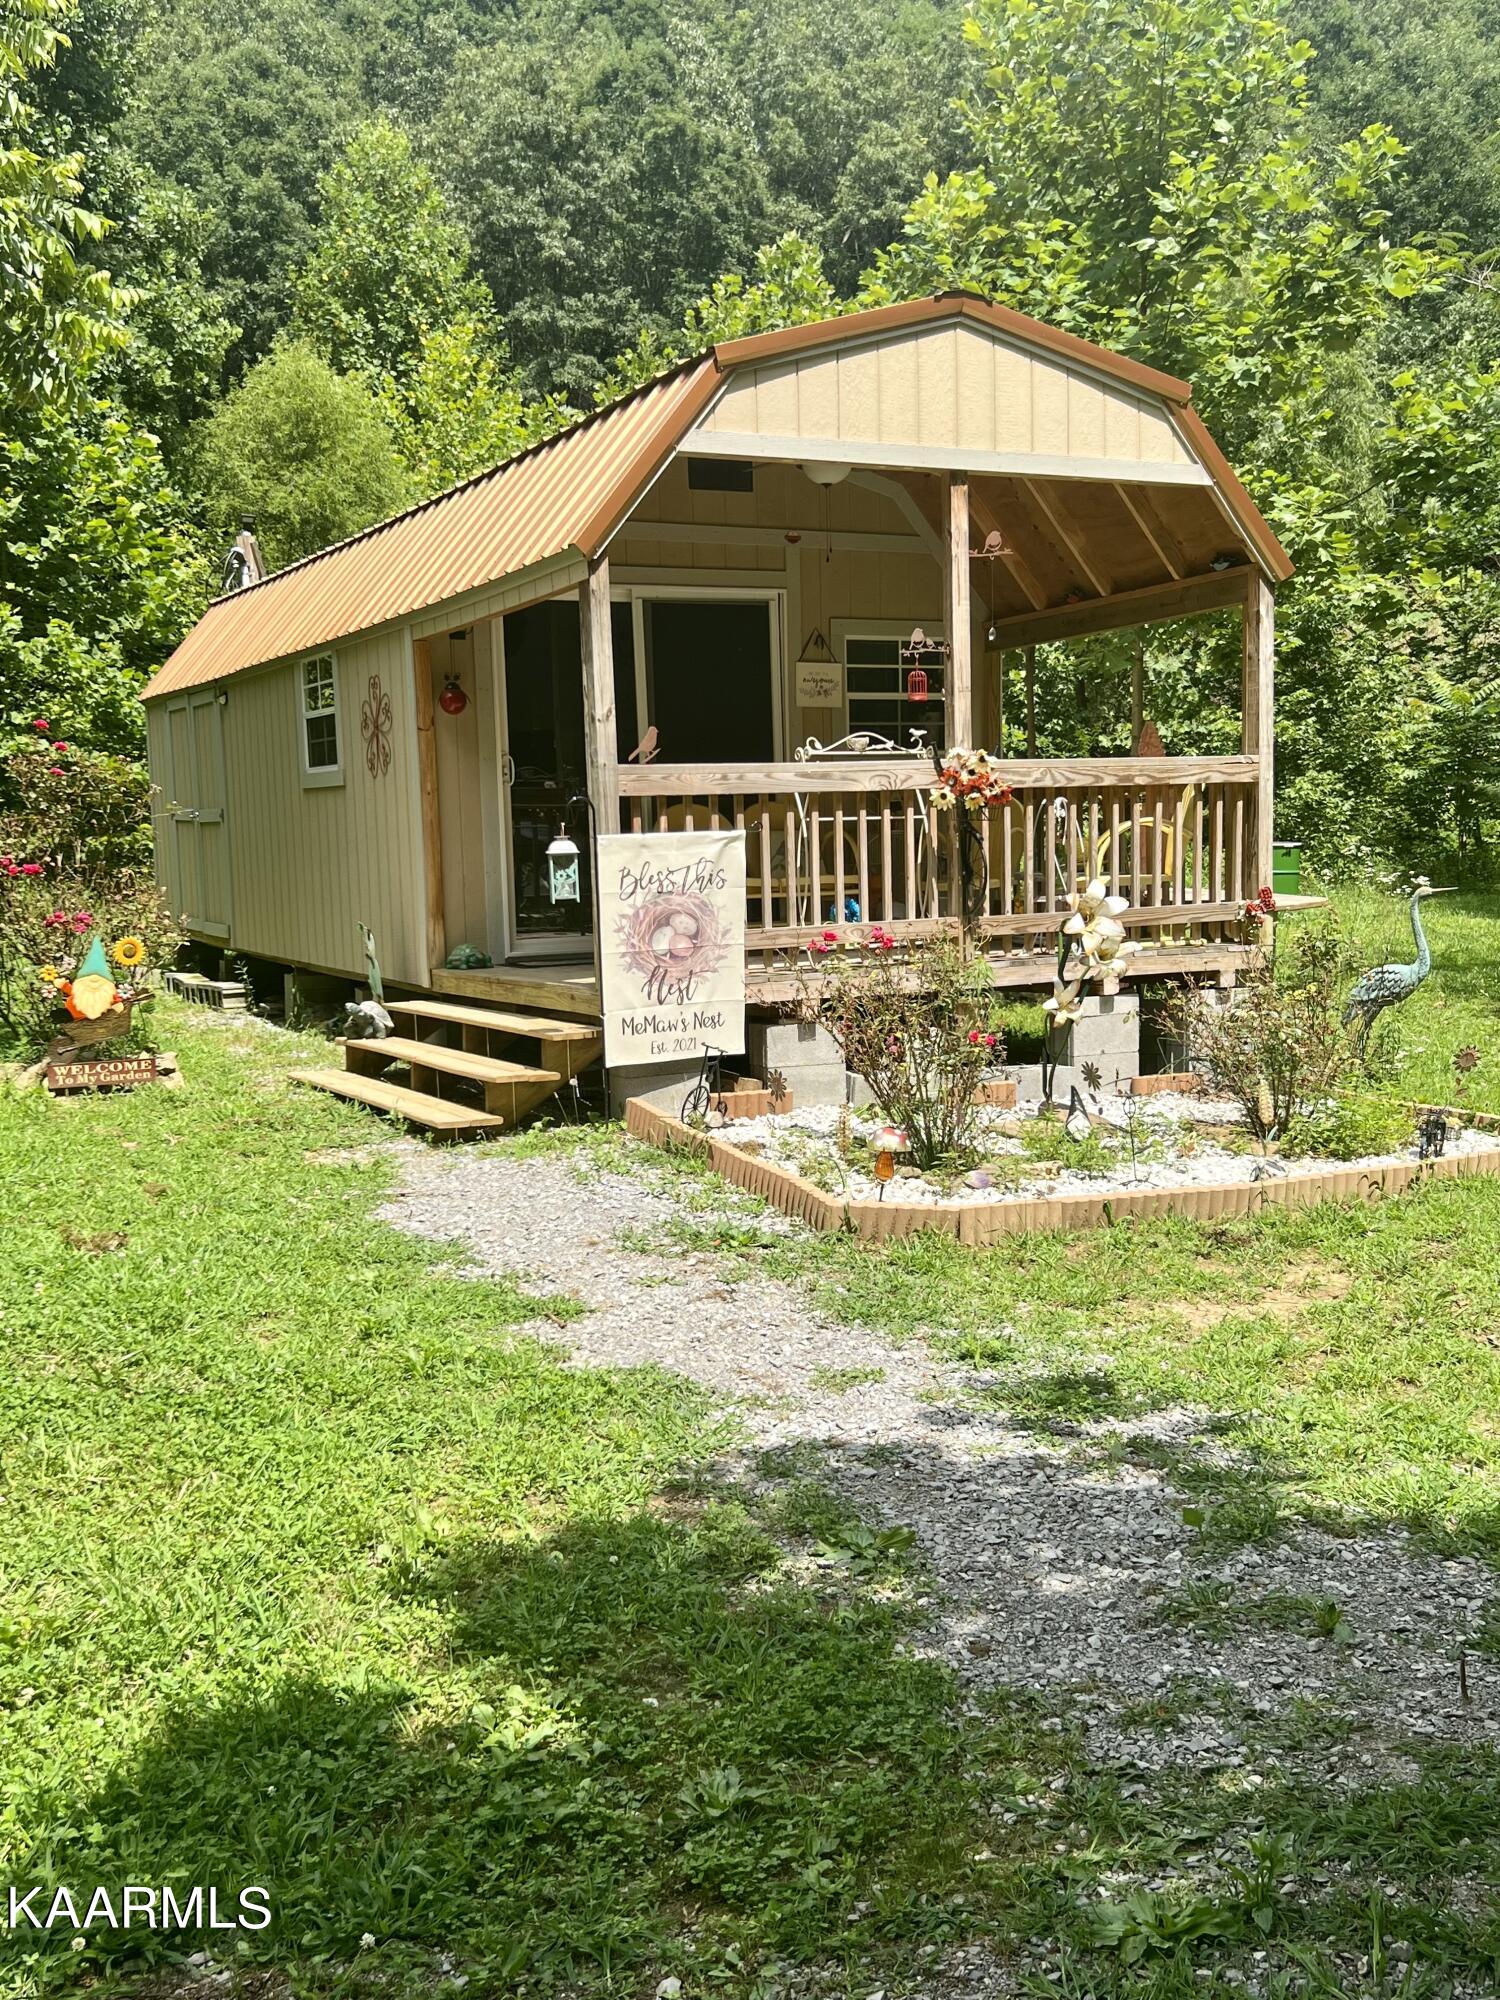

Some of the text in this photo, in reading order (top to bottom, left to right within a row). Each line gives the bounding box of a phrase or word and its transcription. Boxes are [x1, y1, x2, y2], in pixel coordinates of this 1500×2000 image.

[619, 857, 727, 901] Bless This
[641, 965, 719, 1005] Nest
[621, 1011, 726, 1036] MeMaw's Nest
[650, 1037, 697, 1055] Est. 2021
[53, 1060, 152, 1076] WELCOME
[56, 1070, 151, 1085] To My Garden
